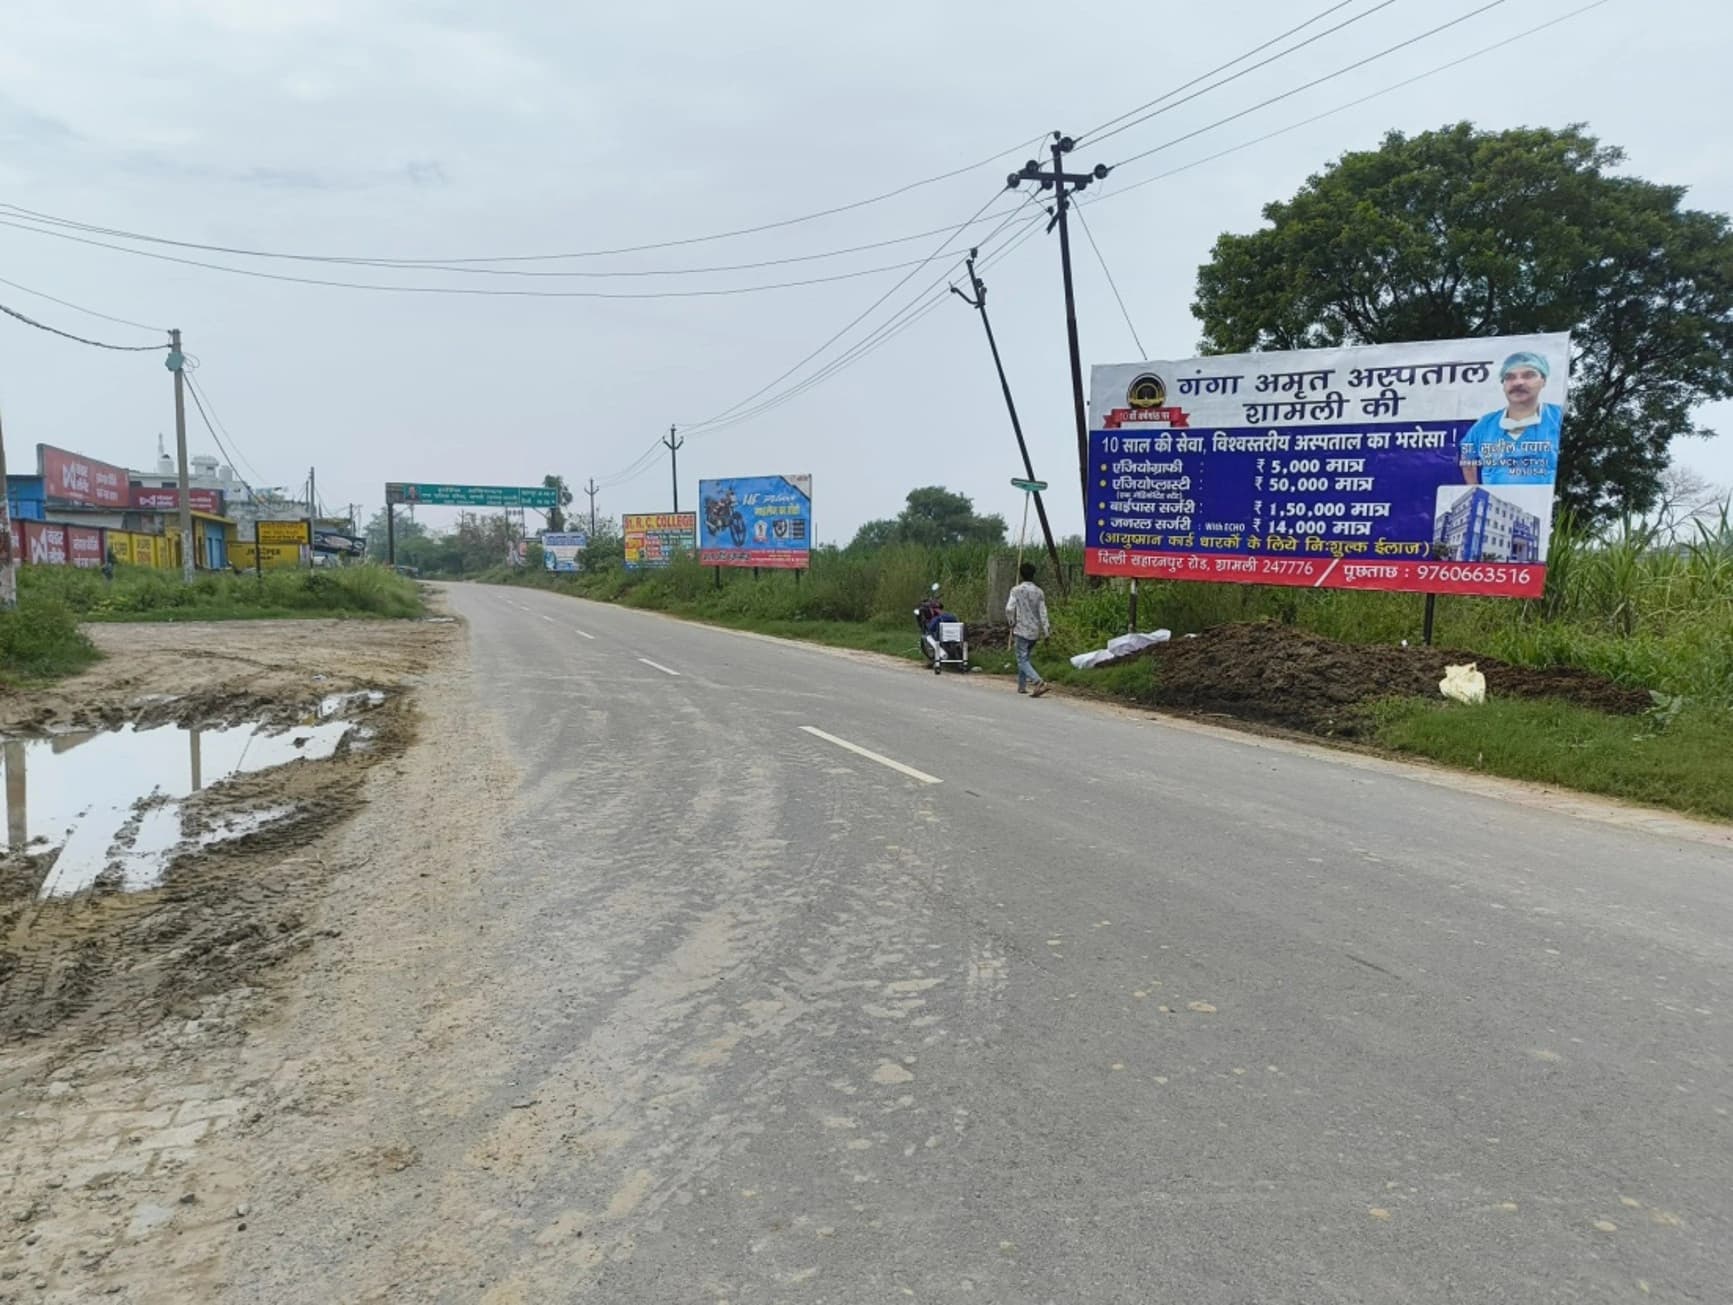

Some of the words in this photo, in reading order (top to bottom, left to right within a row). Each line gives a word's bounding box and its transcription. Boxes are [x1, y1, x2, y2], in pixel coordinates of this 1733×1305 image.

[1177, 369, 1244, 397] गंगा
[1255, 369, 1336, 402] अमृत
[1347, 360, 1494, 390] अस्पताल
[1243, 391, 1350, 424] शामली
[1361, 389, 1405, 418] की
[1101, 437, 1119, 455] 10
[1122, 438, 1155, 455] साल
[1157, 432, 1173, 454] की
[1212, 430, 1290, 452] विश्वस्तरीय
[1294, 434, 1361, 451] अस्पताल
[1365, 433, 1392, 450] का
[1394, 429, 1446, 449] भरोसा
[1256, 459, 1265, 474] ₹
[1270, 458, 1323, 476] 5,000
[1325, 457, 1365, 473] मात्र
[1254, 476, 1263, 491] ₹
[1268, 476, 1329, 493] 50,000
[1332, 475, 1374, 492] मात्र
[1110, 498, 1155, 515] बाईपास
[1159, 497, 1195, 515] सर्जरी
[1253, 501, 1263, 517] ₹
[1269, 501, 1346, 520] 1,50,000
[1349, 501, 1392, 518] मात्र
[656, 514, 694, 528] COLLEGE
[1110, 518, 1153, 530] जनरल
[1155, 516, 1191, 531] सर्जरी
[1252, 520, 1262, 535] ₹
[1268, 519, 1328, 537] 14,000
[1330, 519, 1372, 536] मात्र
[1168, 531, 1194, 549] कार्ड
[1199, 533, 1242, 549] धारकों
[1247, 535, 1262, 551] के
[1267, 536, 1300, 553] लिये
[1097, 549, 1130, 566] दिल्ली
[1131, 551, 1183, 571] सहारनपुर
[1214, 553, 1259, 572] शामली
[1263, 559, 1314, 577] 247776
[1344, 563, 1399, 585] पूछताछ
[1417, 565, 1532, 586] 9760663516
